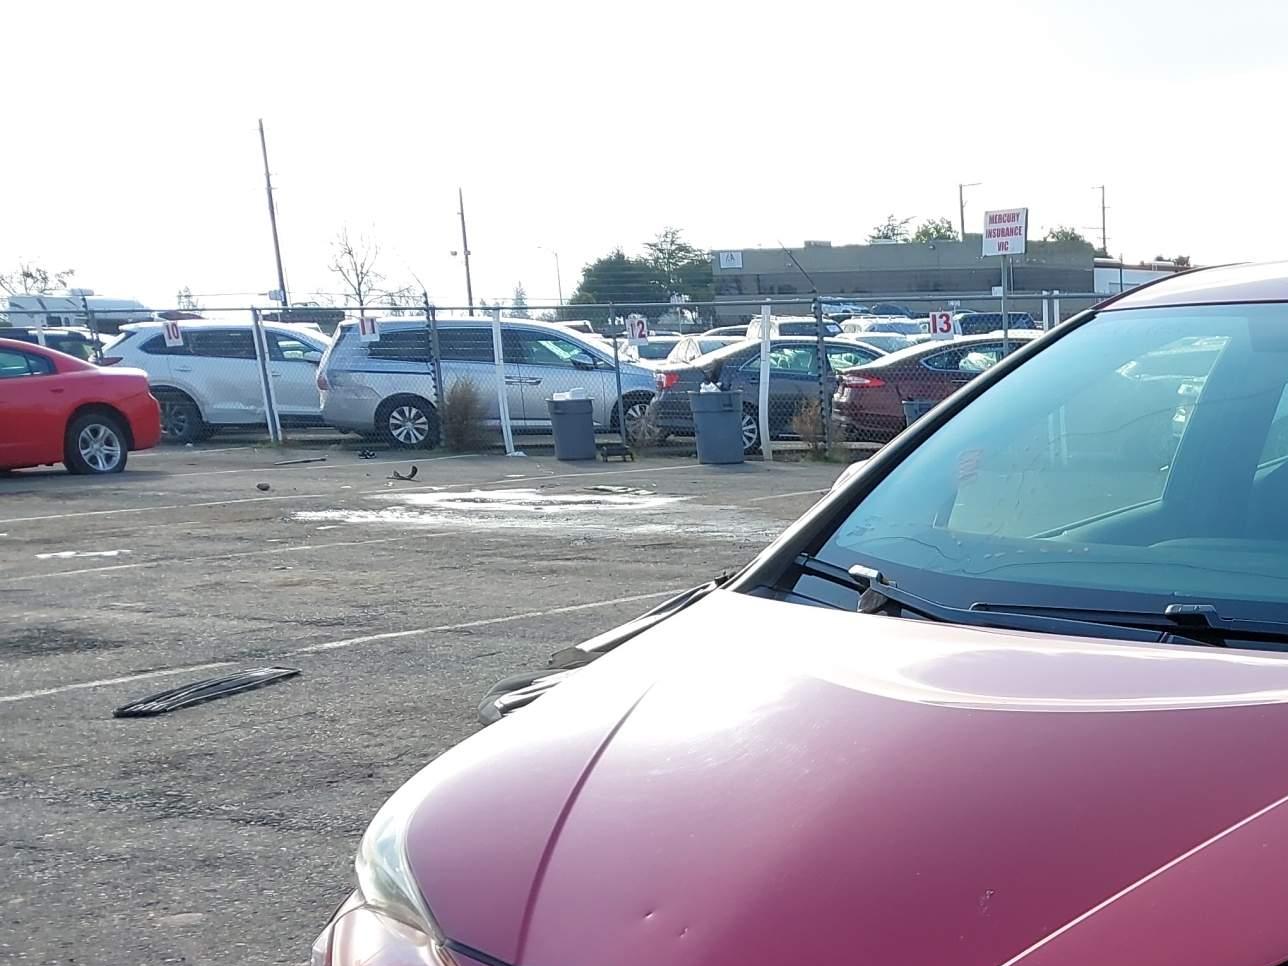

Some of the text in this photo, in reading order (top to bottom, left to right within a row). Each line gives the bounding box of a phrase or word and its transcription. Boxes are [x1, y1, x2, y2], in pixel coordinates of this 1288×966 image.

[988, 212, 1021, 225] MERCURY
[985, 226, 1023, 239] INSURANCE
[997, 240, 1009, 252] VIC
[165, 322, 180, 340] 10
[629, 319, 646, 339] 12
[931, 313, 952, 334] 13
